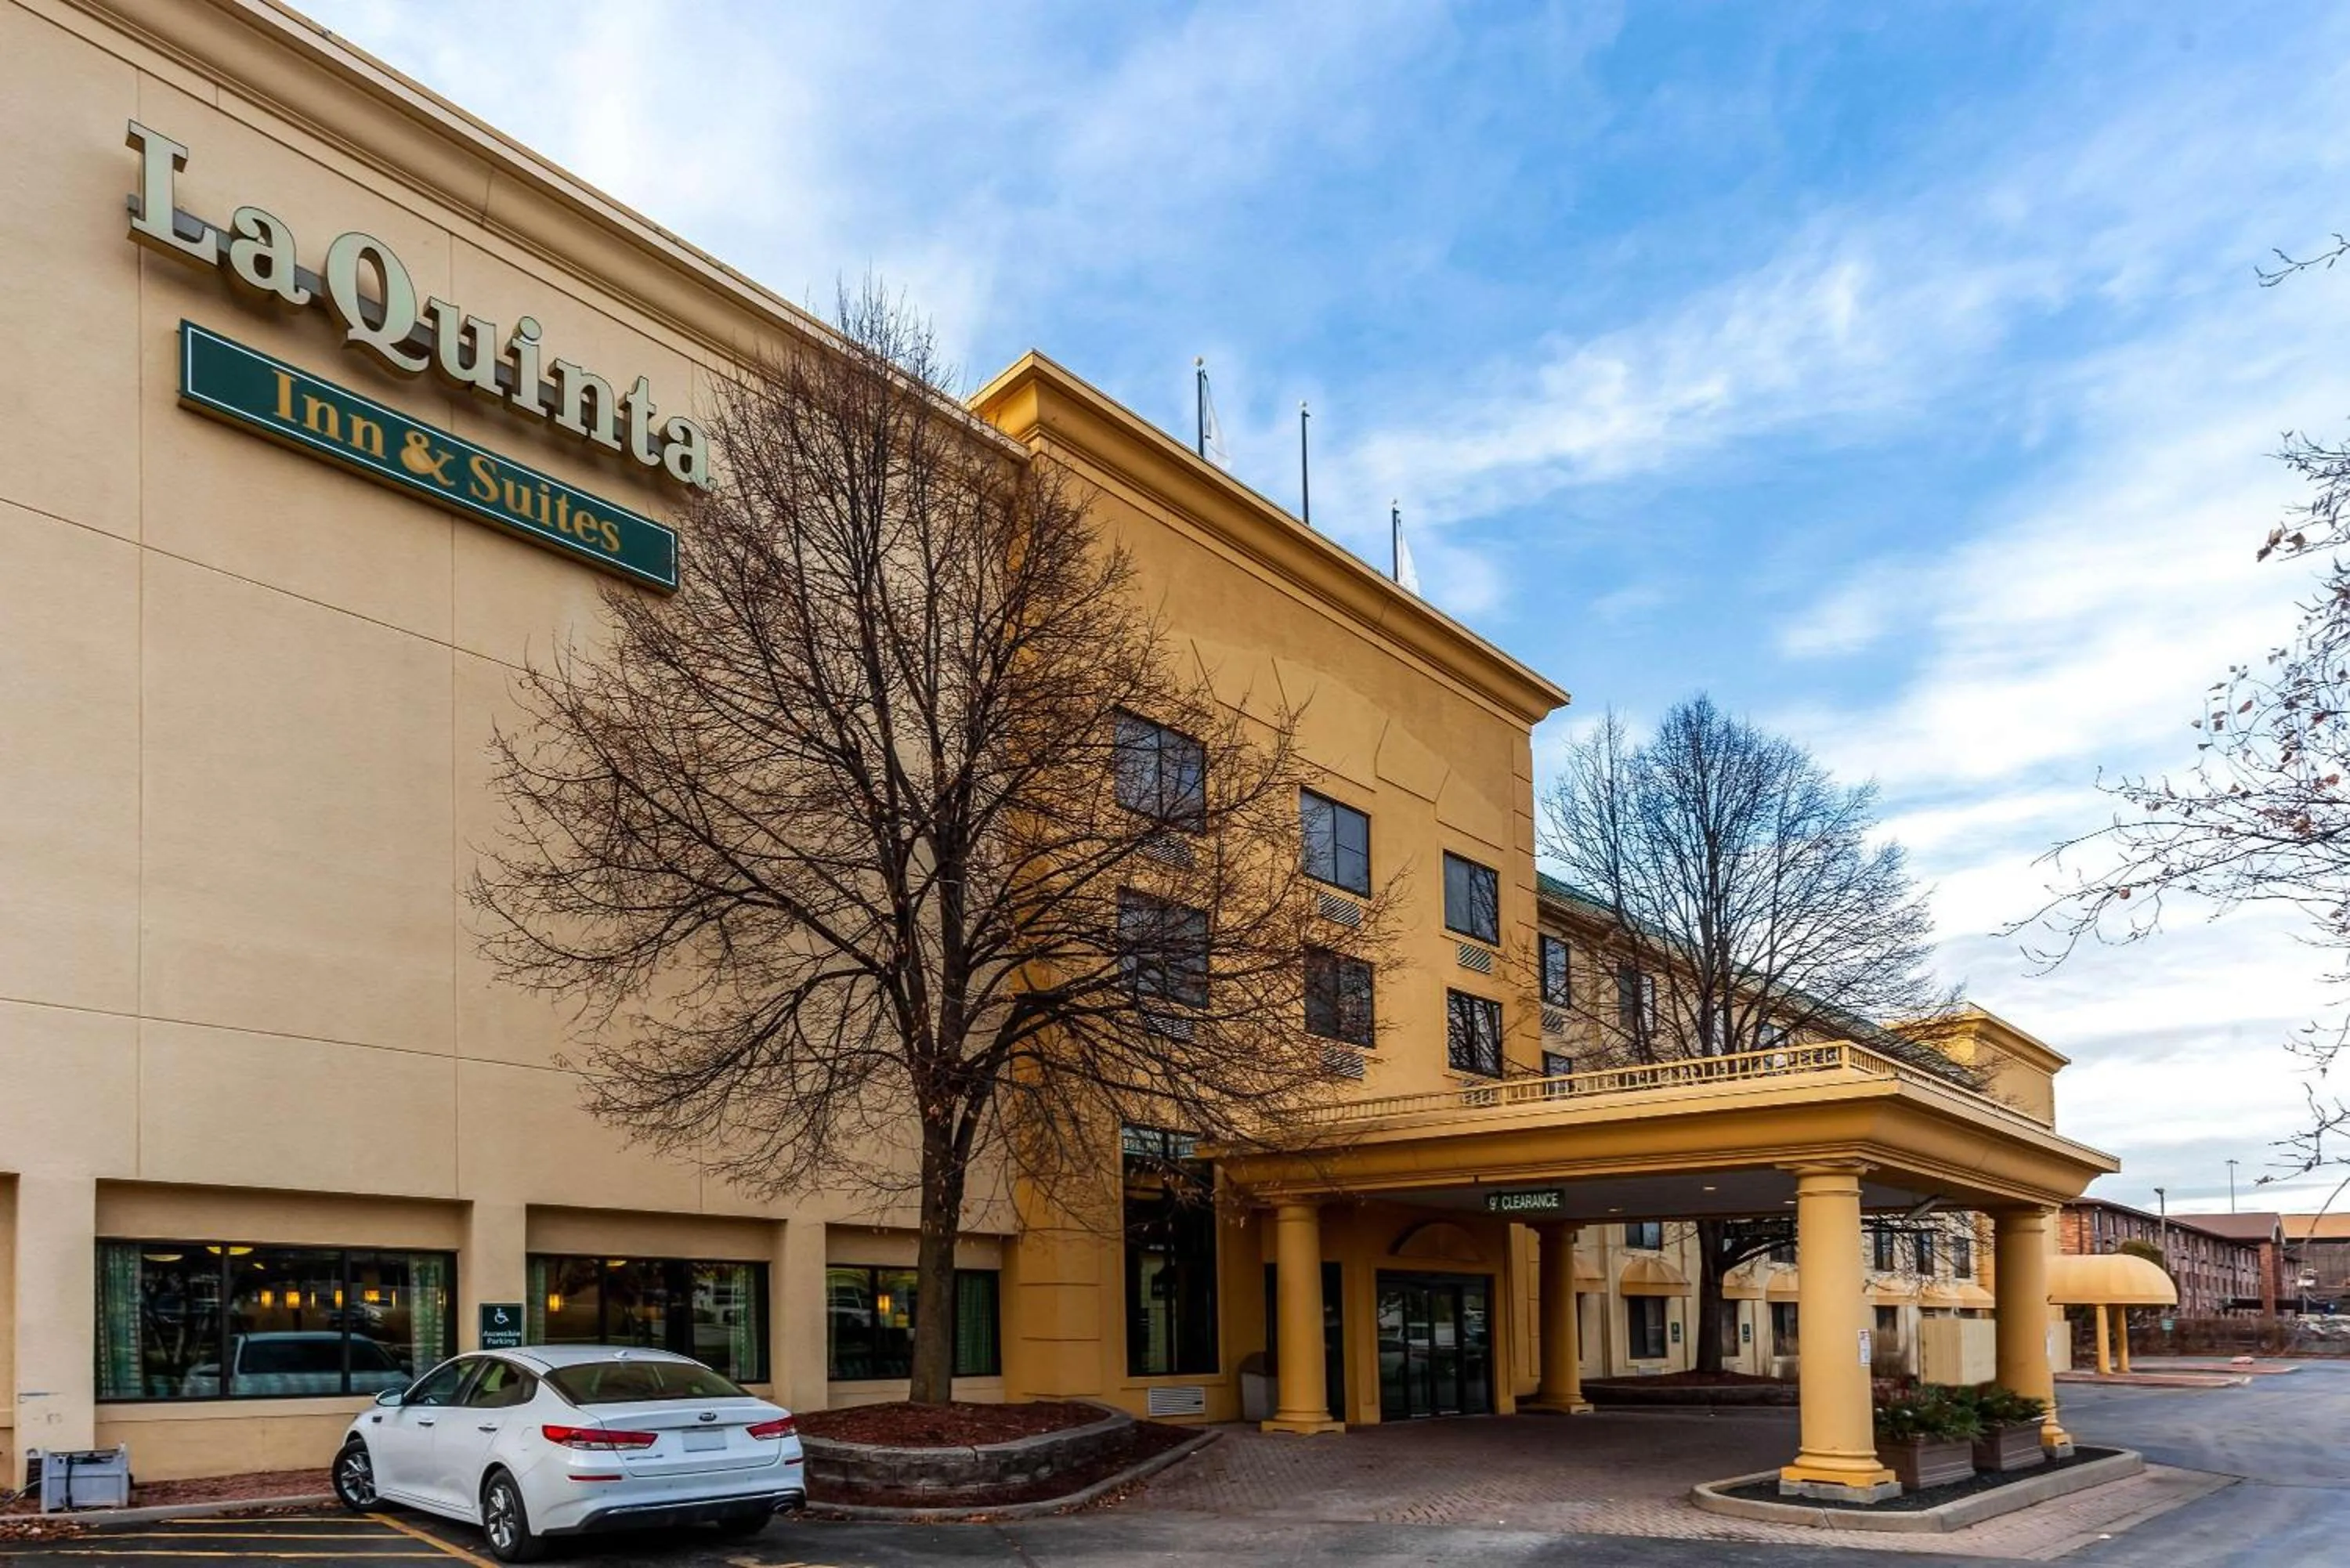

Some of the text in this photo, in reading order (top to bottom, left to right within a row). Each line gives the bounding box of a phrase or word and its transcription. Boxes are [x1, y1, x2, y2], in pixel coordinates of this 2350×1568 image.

[127, 118, 310, 305] La
[273, 370, 621, 553] Inn & Suites
[1502, 1192, 1560, 1210] CLEARANCE
[486, 1337, 516, 1346] Parking
